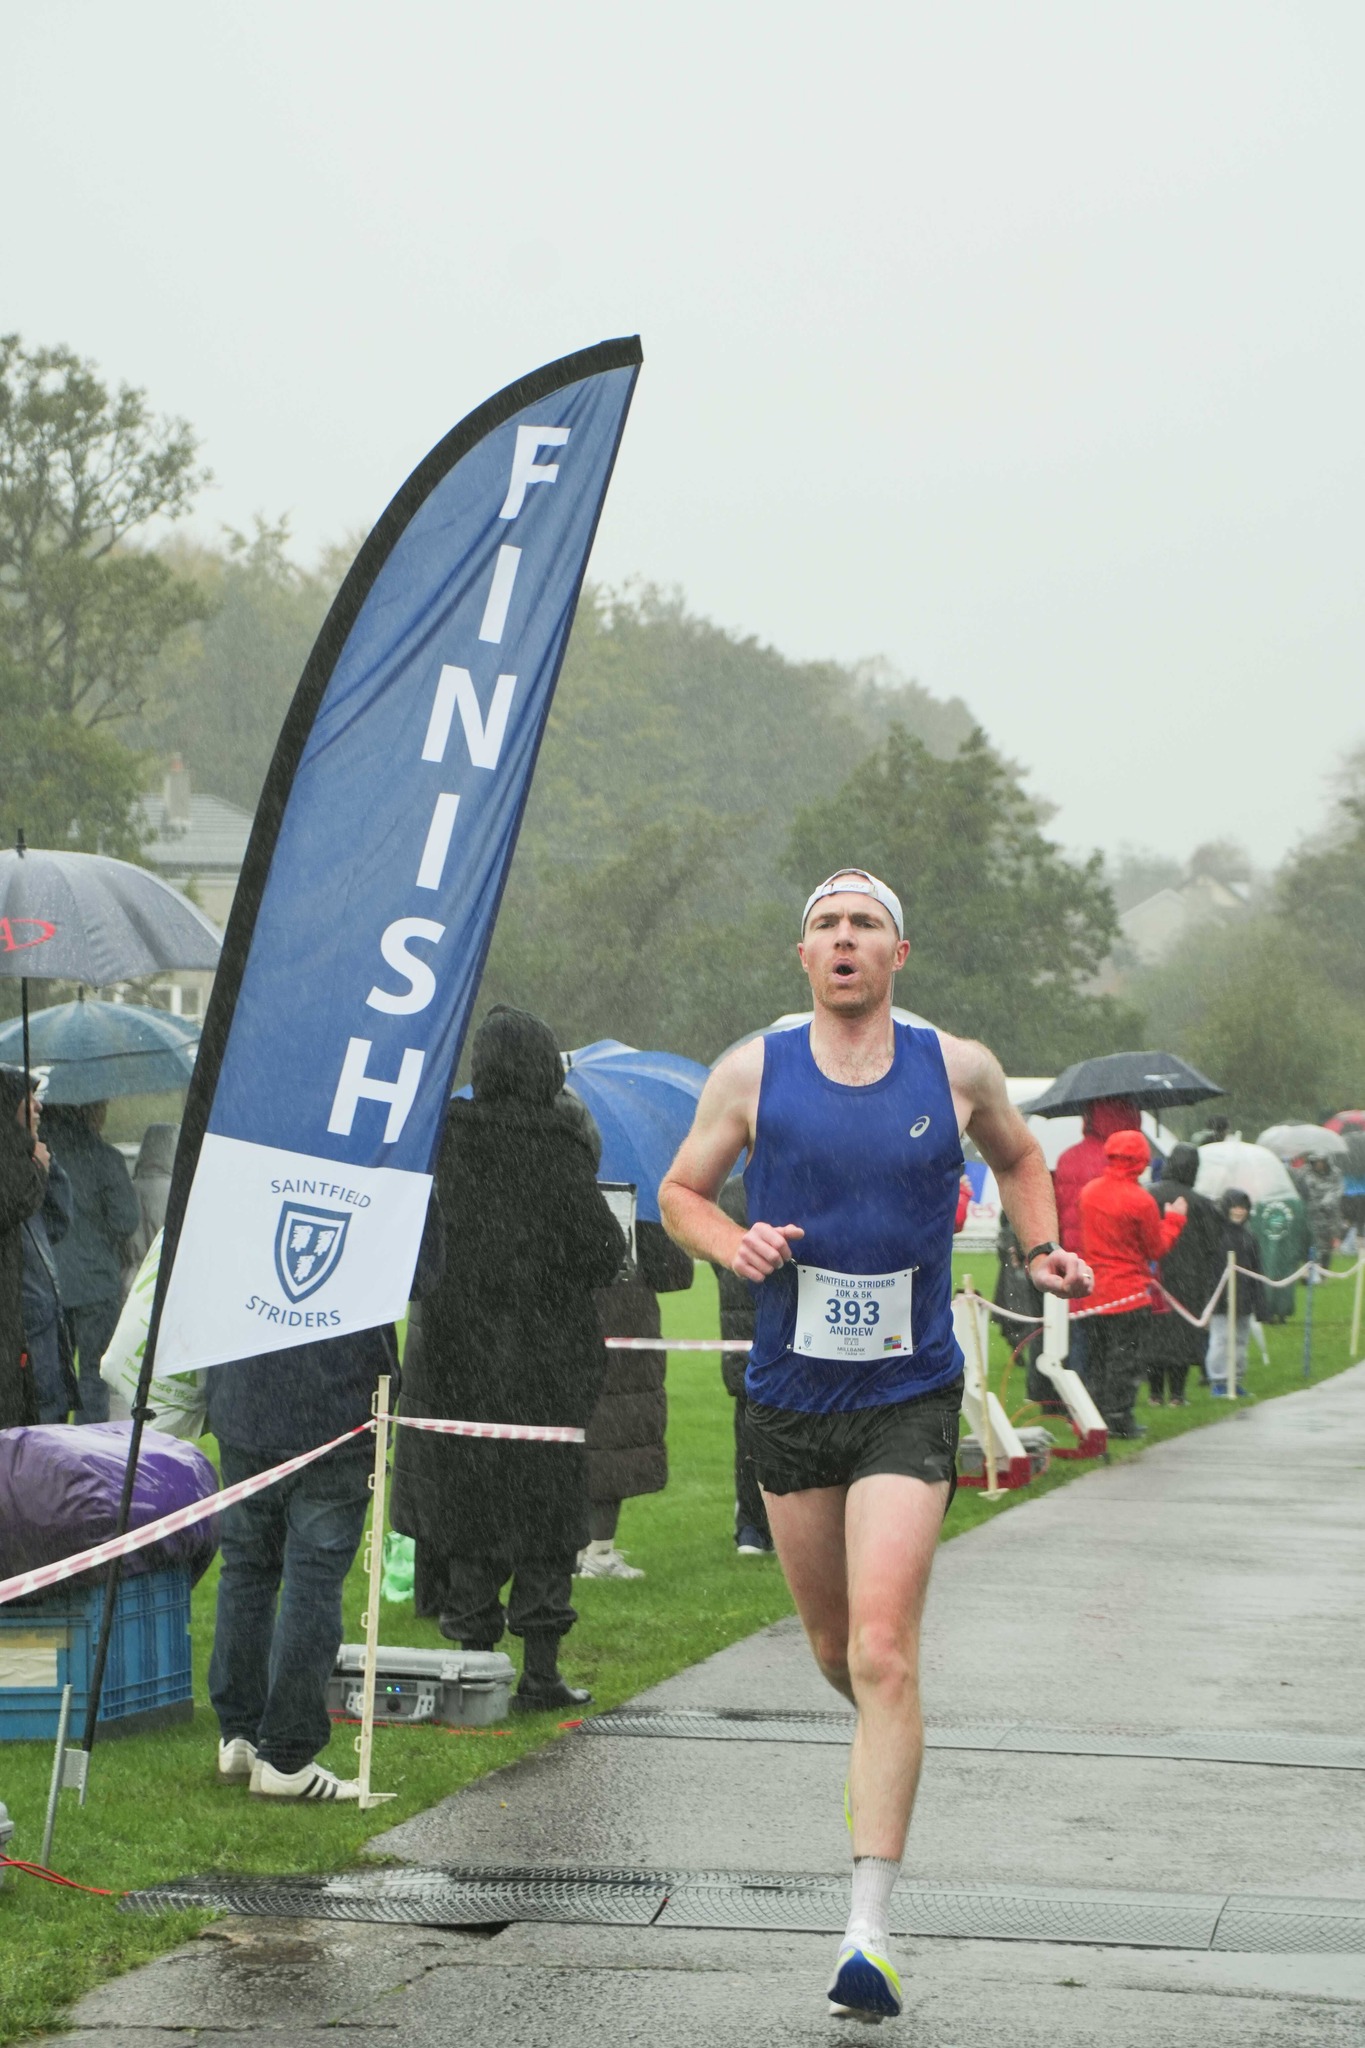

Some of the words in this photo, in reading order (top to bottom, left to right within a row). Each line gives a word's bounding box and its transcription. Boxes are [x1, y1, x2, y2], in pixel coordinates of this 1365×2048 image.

[327, 425, 571, 1144] FINISH
[271, 1179, 372, 1209] SAINTFIELD
[816, 1273, 856, 1288] SAINTFIELD
[857, 1278, 896, 1289] STRIDERS
[835, 1289, 851, 1298] 10K
[852, 1290, 860, 1299] &
[861, 1291, 872, 1299] 5K
[245, 1295, 341, 1328] STRIDERS
[825, 1298, 880, 1326] 393
[829, 1325, 874, 1337] ANDREW
